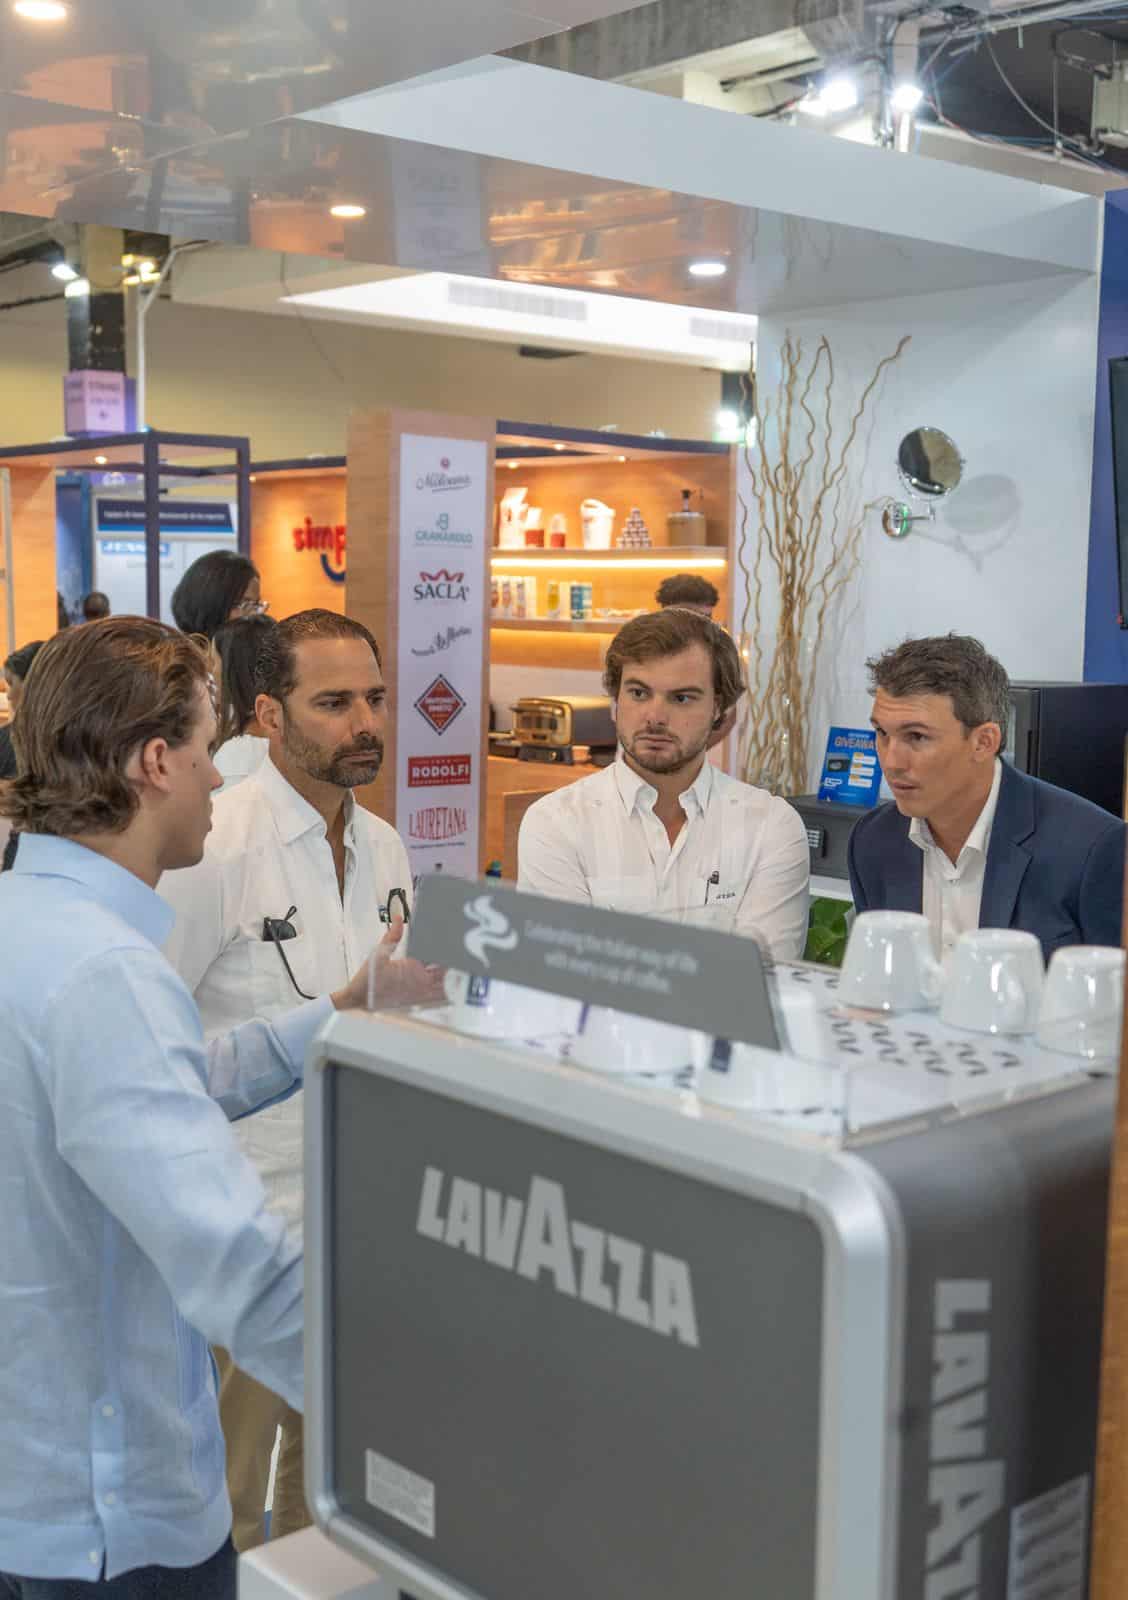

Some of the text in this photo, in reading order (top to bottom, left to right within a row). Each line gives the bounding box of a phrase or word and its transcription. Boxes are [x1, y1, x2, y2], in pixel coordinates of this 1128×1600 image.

[411, 763, 469, 778] RODOLFI
[408, 807, 468, 840] LAURETANA
[416, 1164, 700, 1348] LAVAZZA
